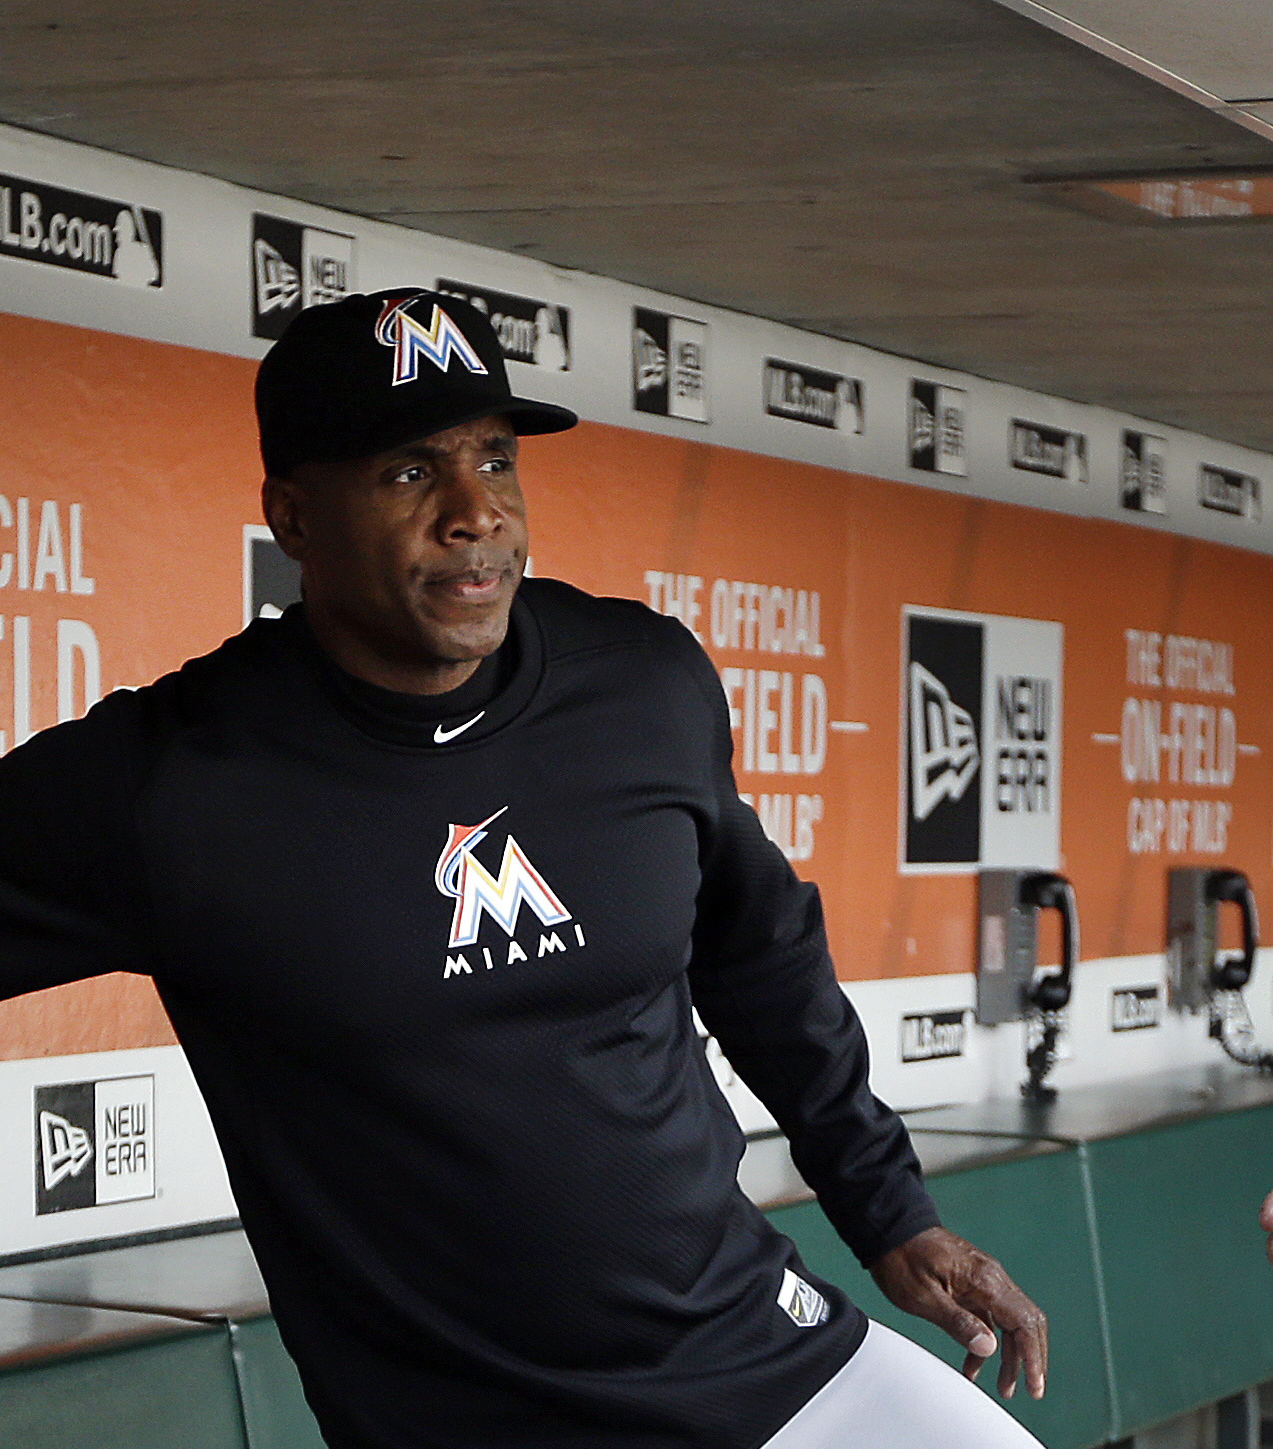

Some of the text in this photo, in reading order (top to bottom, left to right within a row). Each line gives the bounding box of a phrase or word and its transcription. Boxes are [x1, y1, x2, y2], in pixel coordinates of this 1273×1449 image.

[710, 577, 826, 658] OFFICIAL
[993, 674, 1053, 744] NEW
[1120, 697, 1237, 788] ON-FIELD
[997, 748, 1051, 814] ERA
[443, 924, 586, 979] MIAMI
[104, 1101, 145, 1138] NEW
[105, 1139, 146, 1176] ERA
